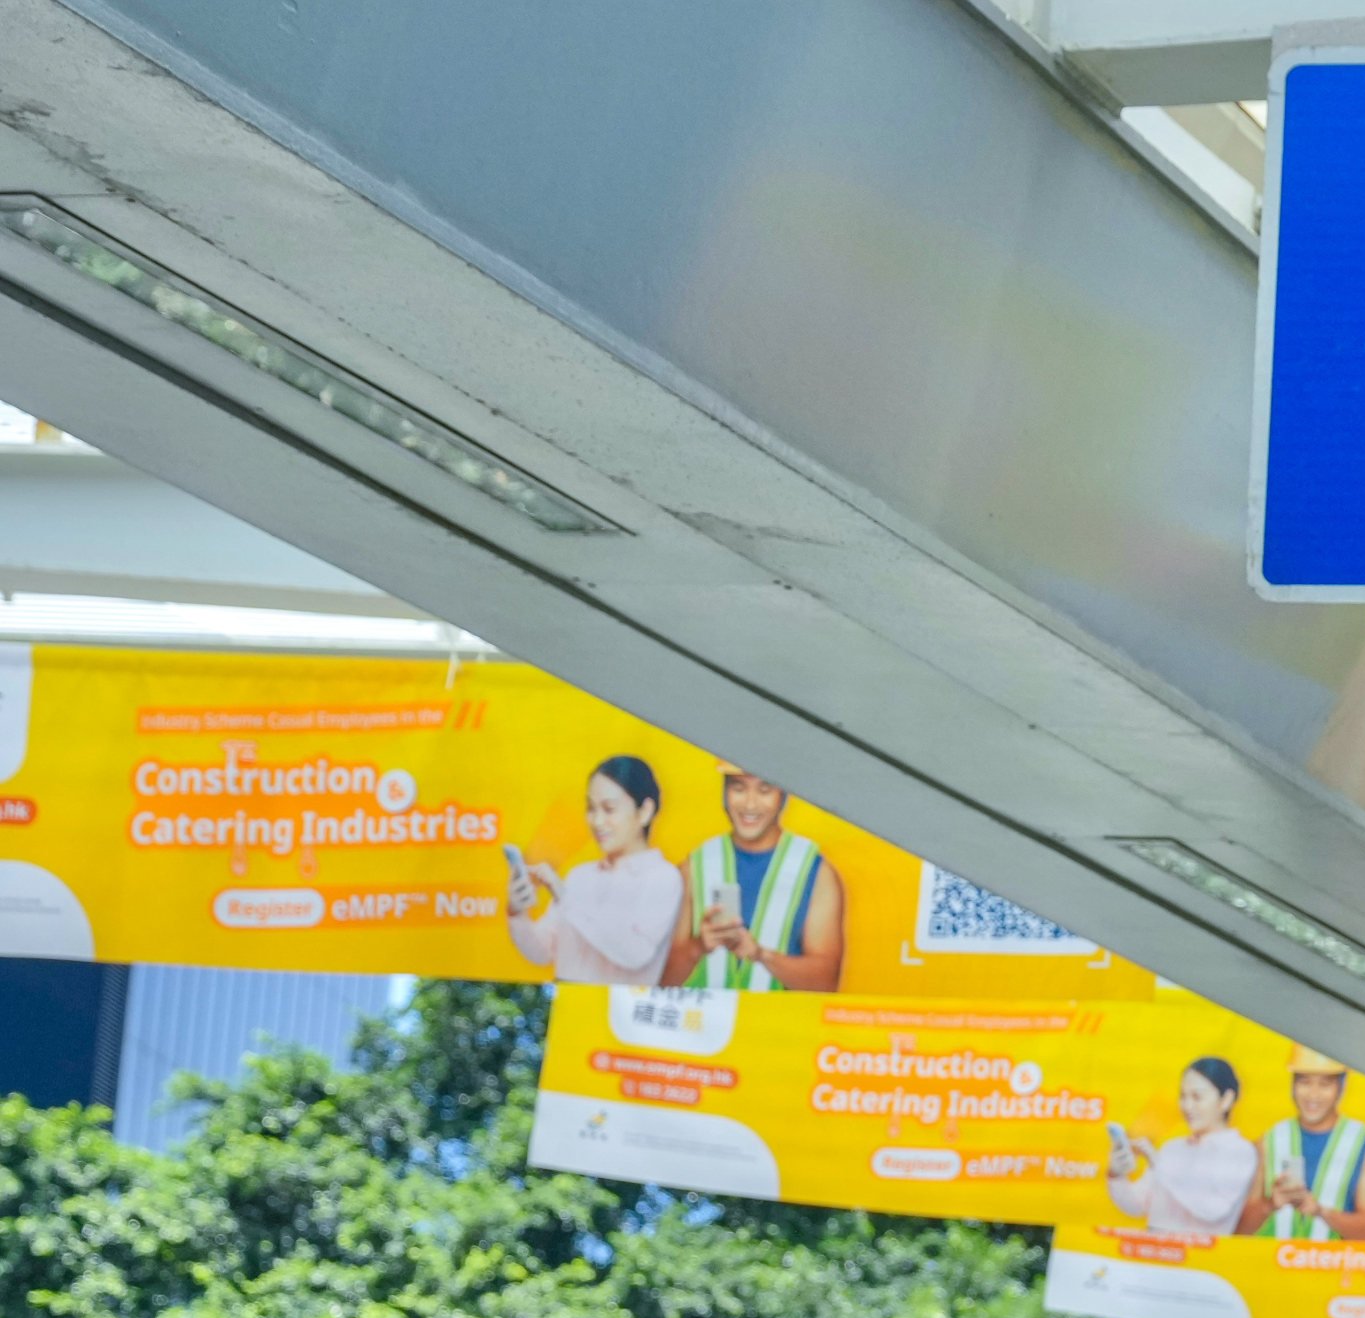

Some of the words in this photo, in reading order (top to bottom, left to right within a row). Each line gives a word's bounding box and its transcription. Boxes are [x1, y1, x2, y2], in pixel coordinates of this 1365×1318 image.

[136, 760, 376, 796] Construction
[131, 811, 294, 854] Catering
[302, 807, 498, 845] Industries
[435, 891, 499, 917] Now
[816, 1046, 1011, 1080] Construction
[812, 1084, 940, 1124] Catering
[948, 1090, 1103, 1120] Industries
